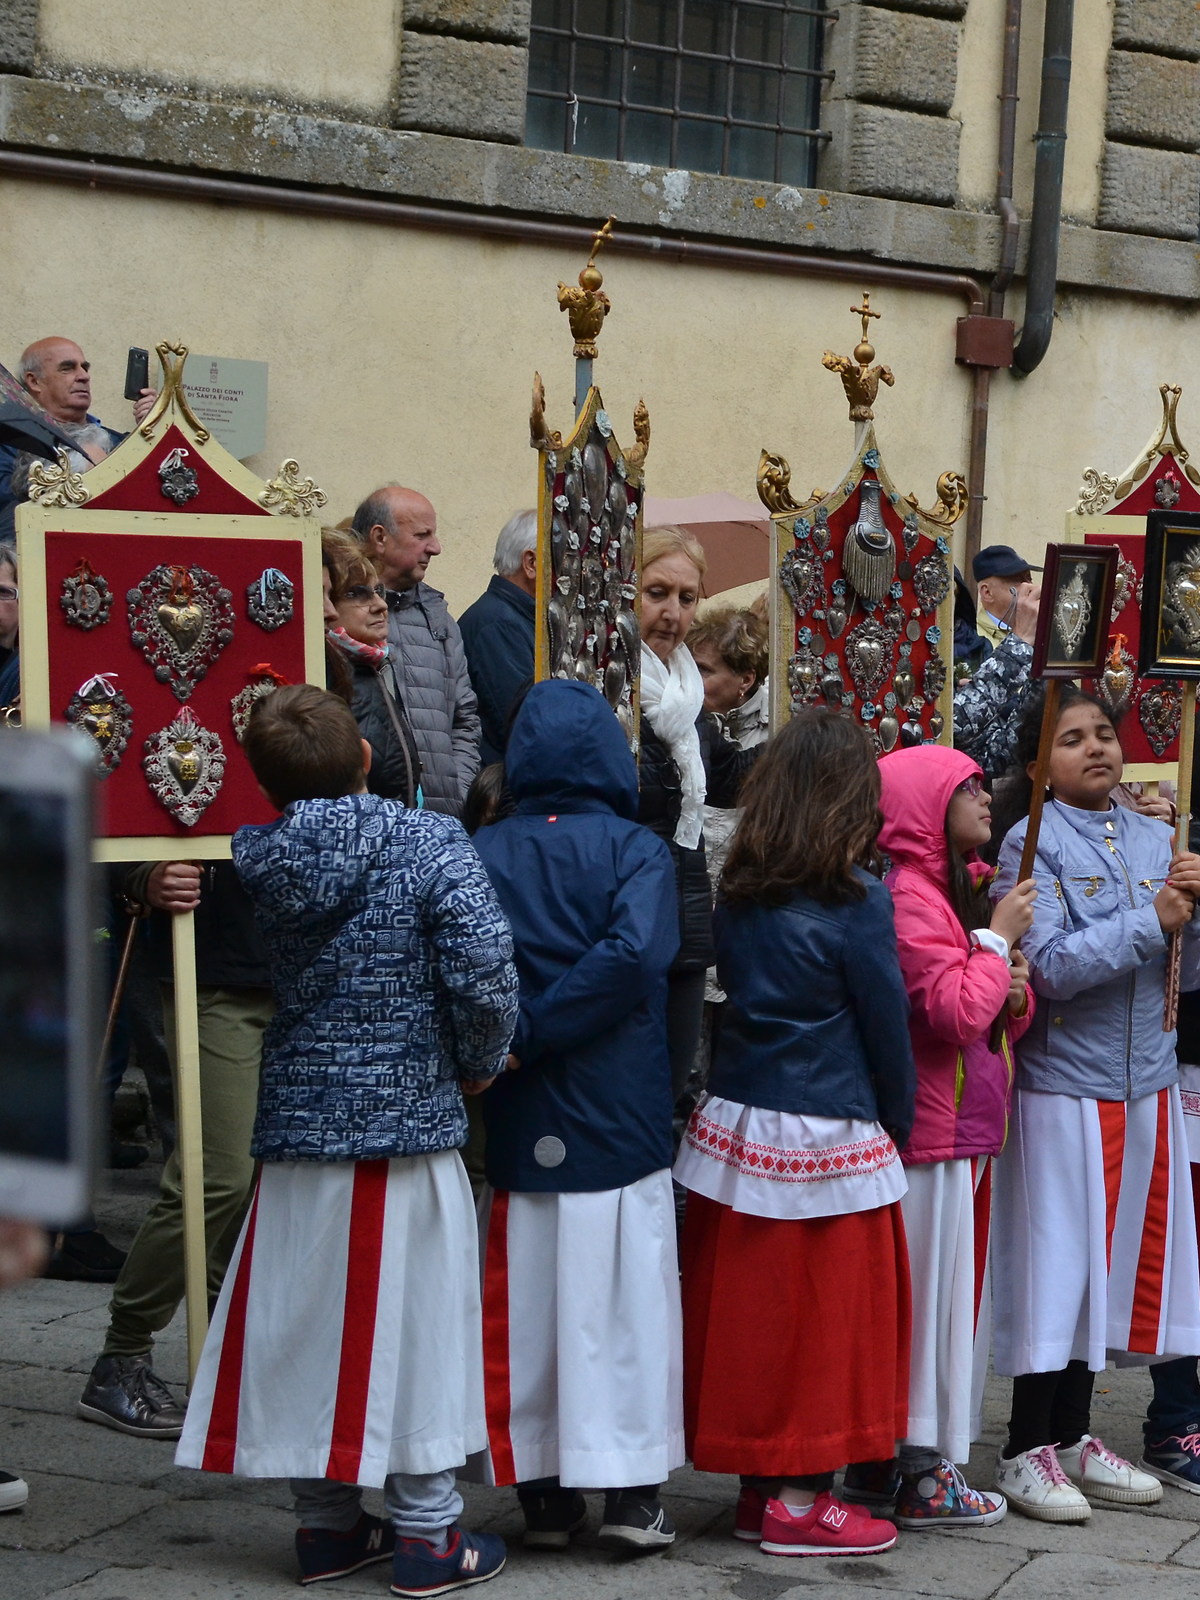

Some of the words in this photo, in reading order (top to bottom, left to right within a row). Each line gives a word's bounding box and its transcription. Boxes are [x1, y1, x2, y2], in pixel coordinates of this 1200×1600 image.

[183, 384, 211, 393] PALAZZO
[196, 392, 217, 400] SANTA
[218, 394, 239, 402] FIORA
[362, 909, 395, 925] PHY
[360, 1006, 394, 1021] PHY
[352, 1100, 387, 1113] PHY
[823, 1505, 848, 1528] N
[461, 1548, 480, 1571] N
